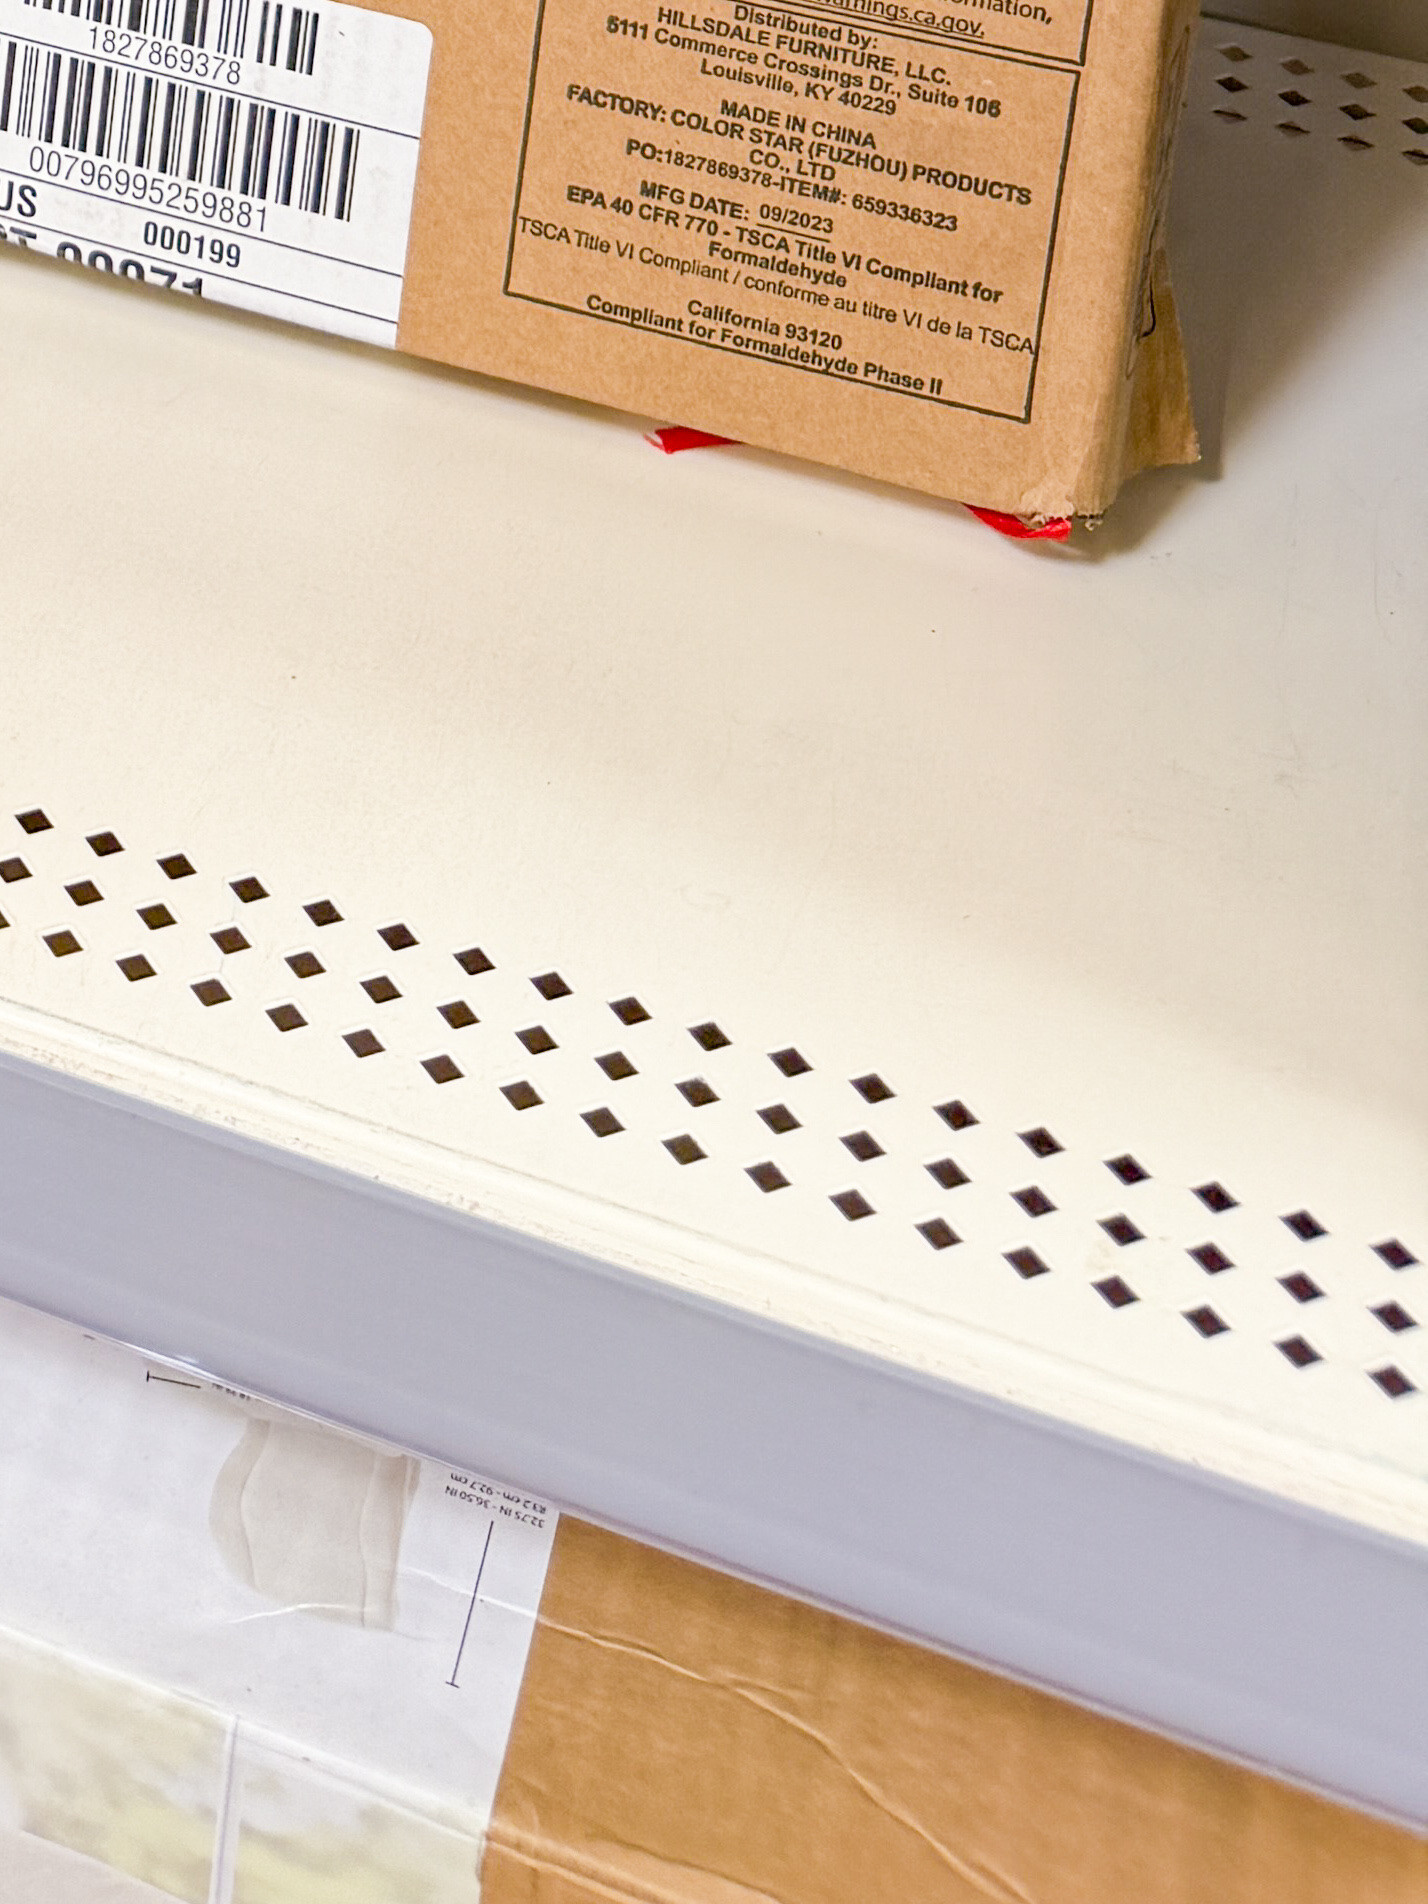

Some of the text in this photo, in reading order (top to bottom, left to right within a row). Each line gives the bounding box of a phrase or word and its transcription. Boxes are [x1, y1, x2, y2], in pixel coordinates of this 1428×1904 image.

[89, 26, 241, 86] 1827869378
[657, 6, 951, 86] HILLSDALE FURNITURE, LLC.
[700, 57, 897, 116] Louisville, KY 40229
[29, 145, 266, 233] 00796995259881
[143, 221, 241, 268] 000199
